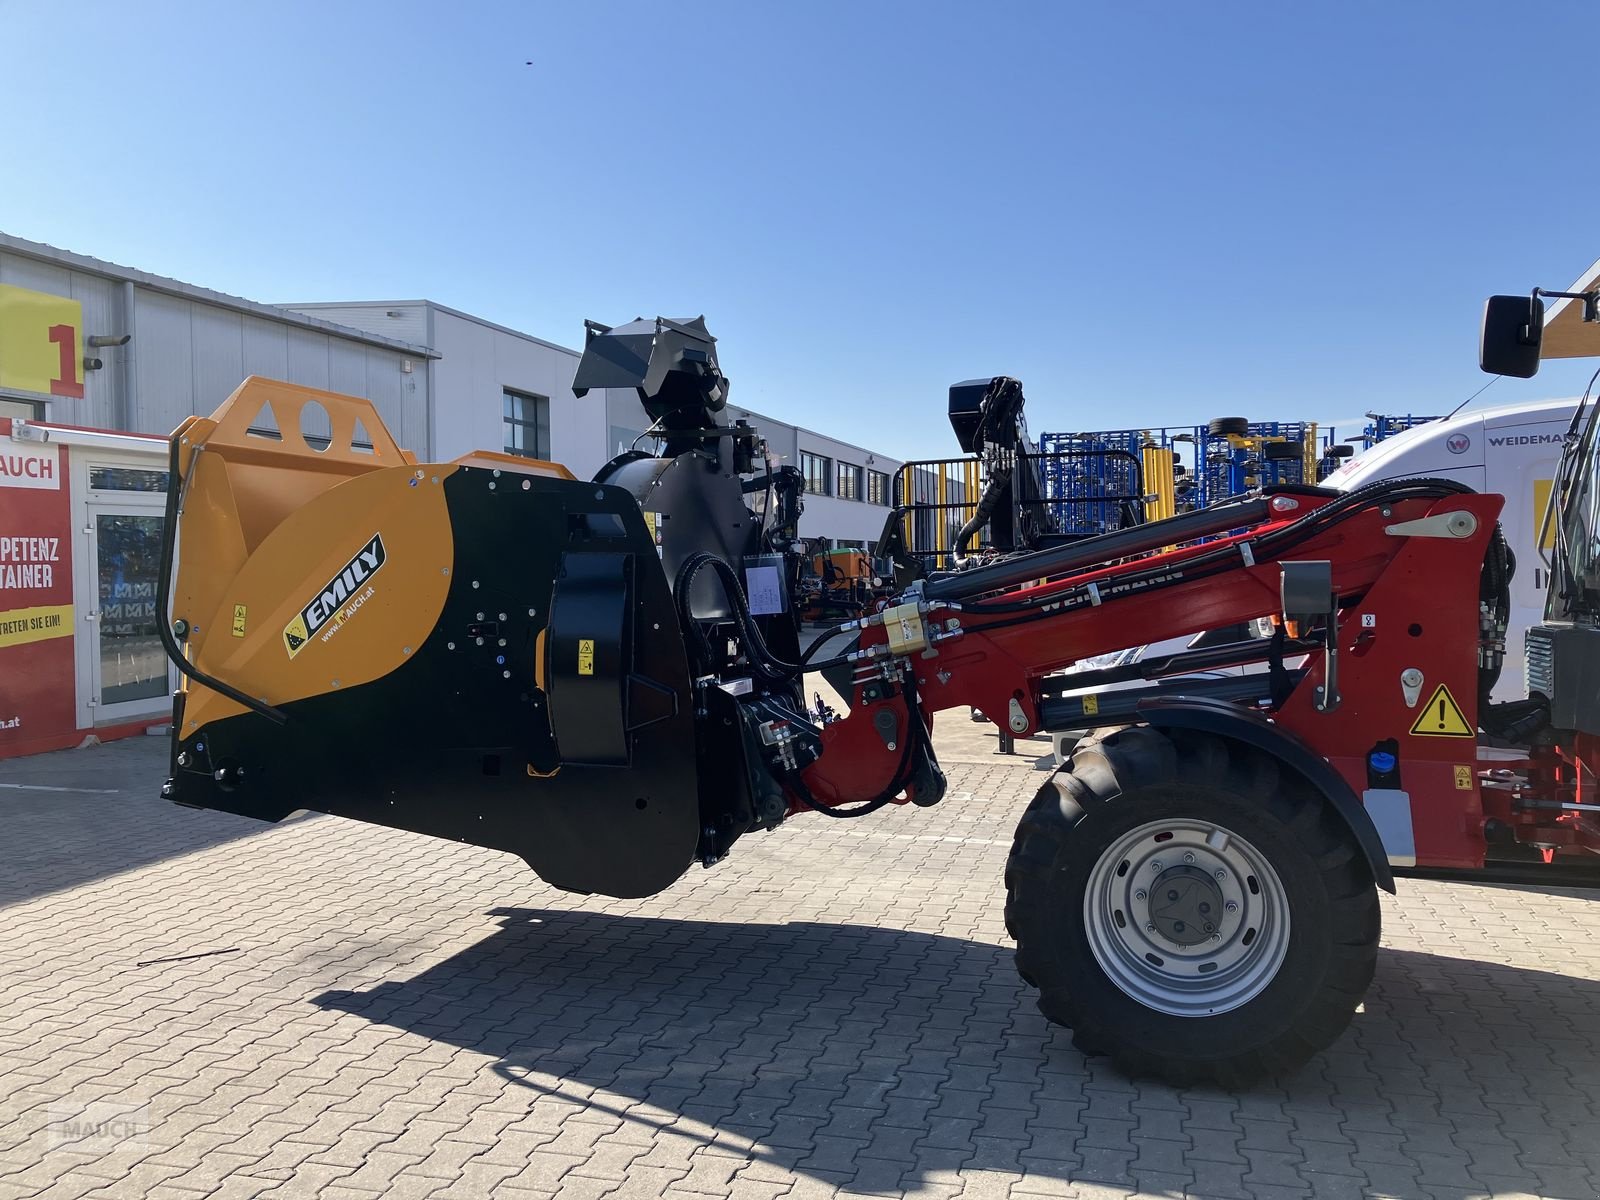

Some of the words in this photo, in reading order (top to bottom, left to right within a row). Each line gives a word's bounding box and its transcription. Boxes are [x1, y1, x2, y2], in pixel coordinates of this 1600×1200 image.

[48, 324, 84, 399] 1
[1488, 434, 1582, 447] WEIDEMAN
[0, 537, 59, 562] PETENZ
[306, 541, 379, 630] EMILY
[30, 617, 43, 630] SIE
[45, 614, 61, 628] EIN!
